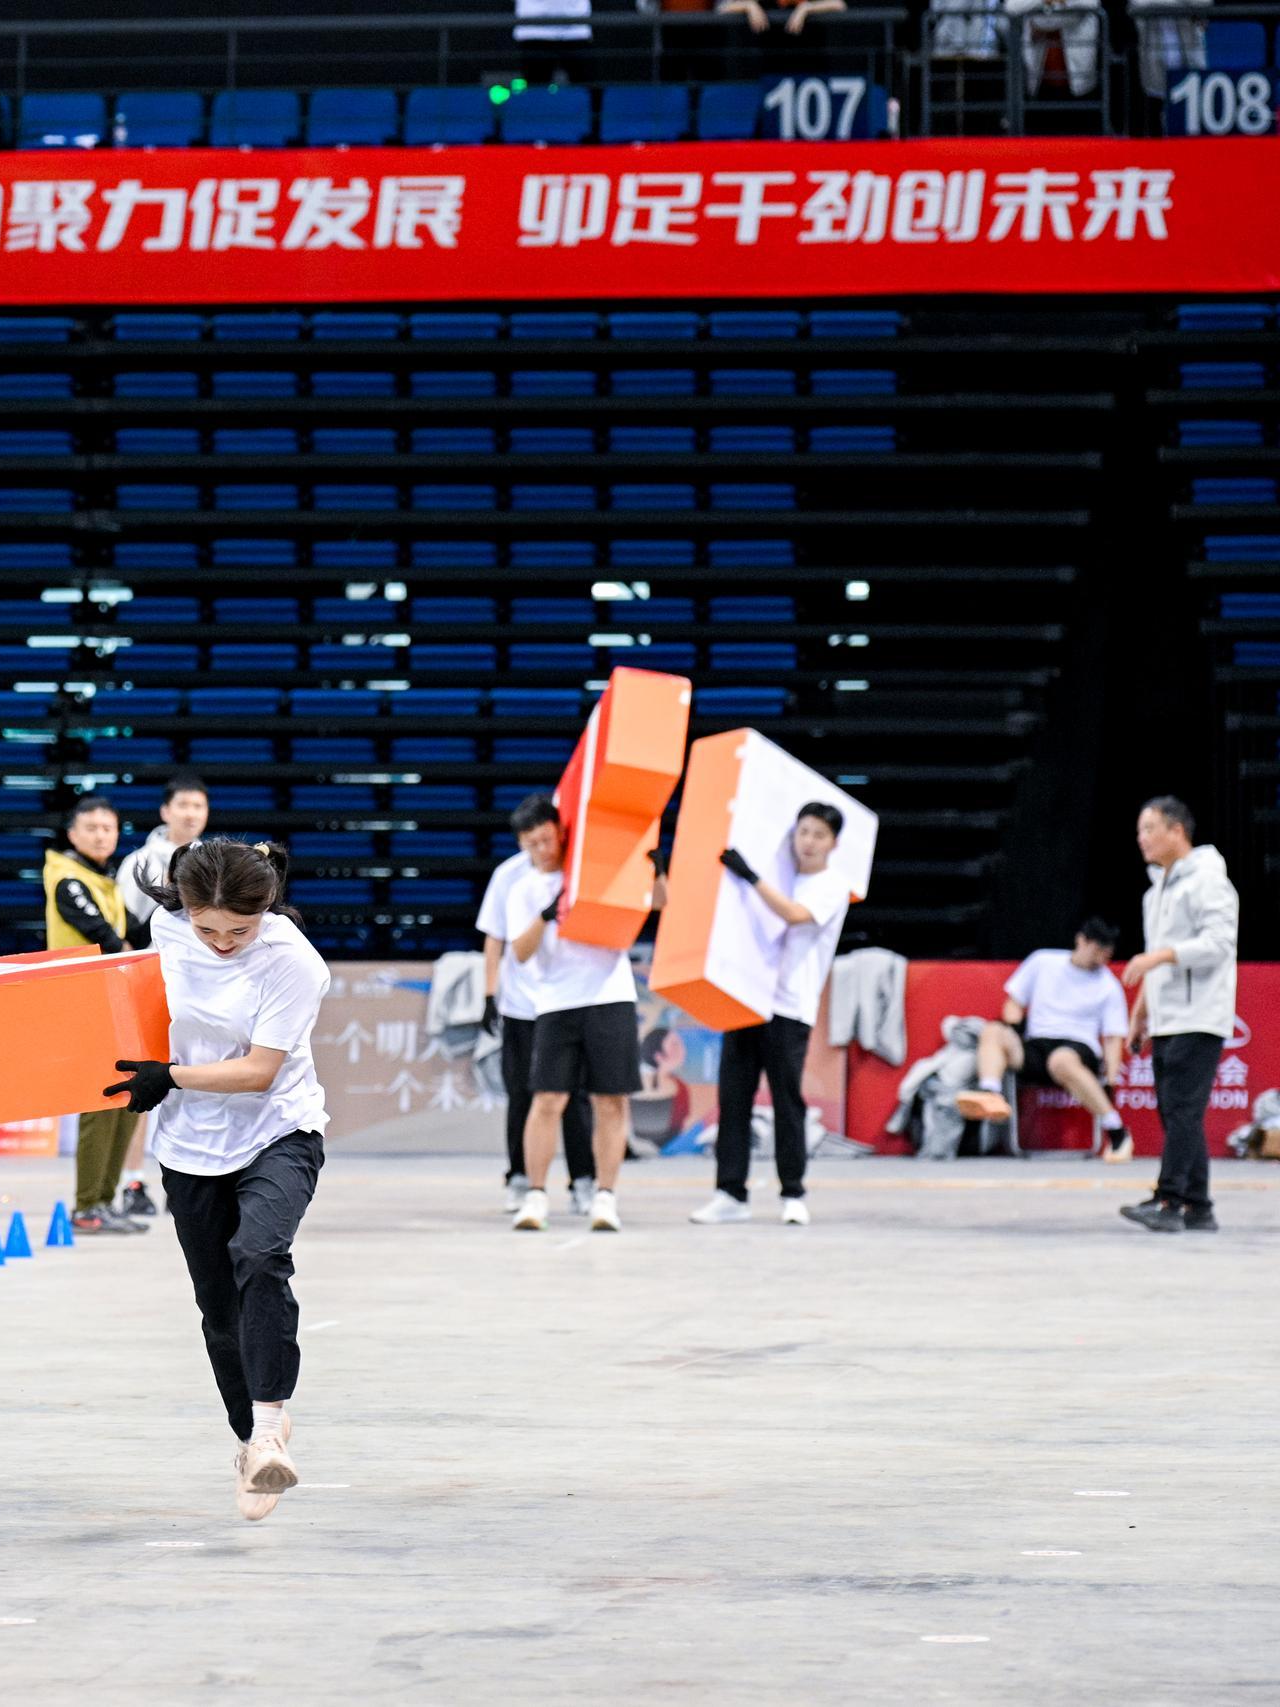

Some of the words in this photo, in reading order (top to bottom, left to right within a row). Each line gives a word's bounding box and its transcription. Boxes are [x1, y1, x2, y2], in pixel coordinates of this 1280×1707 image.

[764, 76, 866, 141] 107
[1170, 71, 1272, 136] 108
[517, 167, 1174, 248] 卯足干劲创未来
